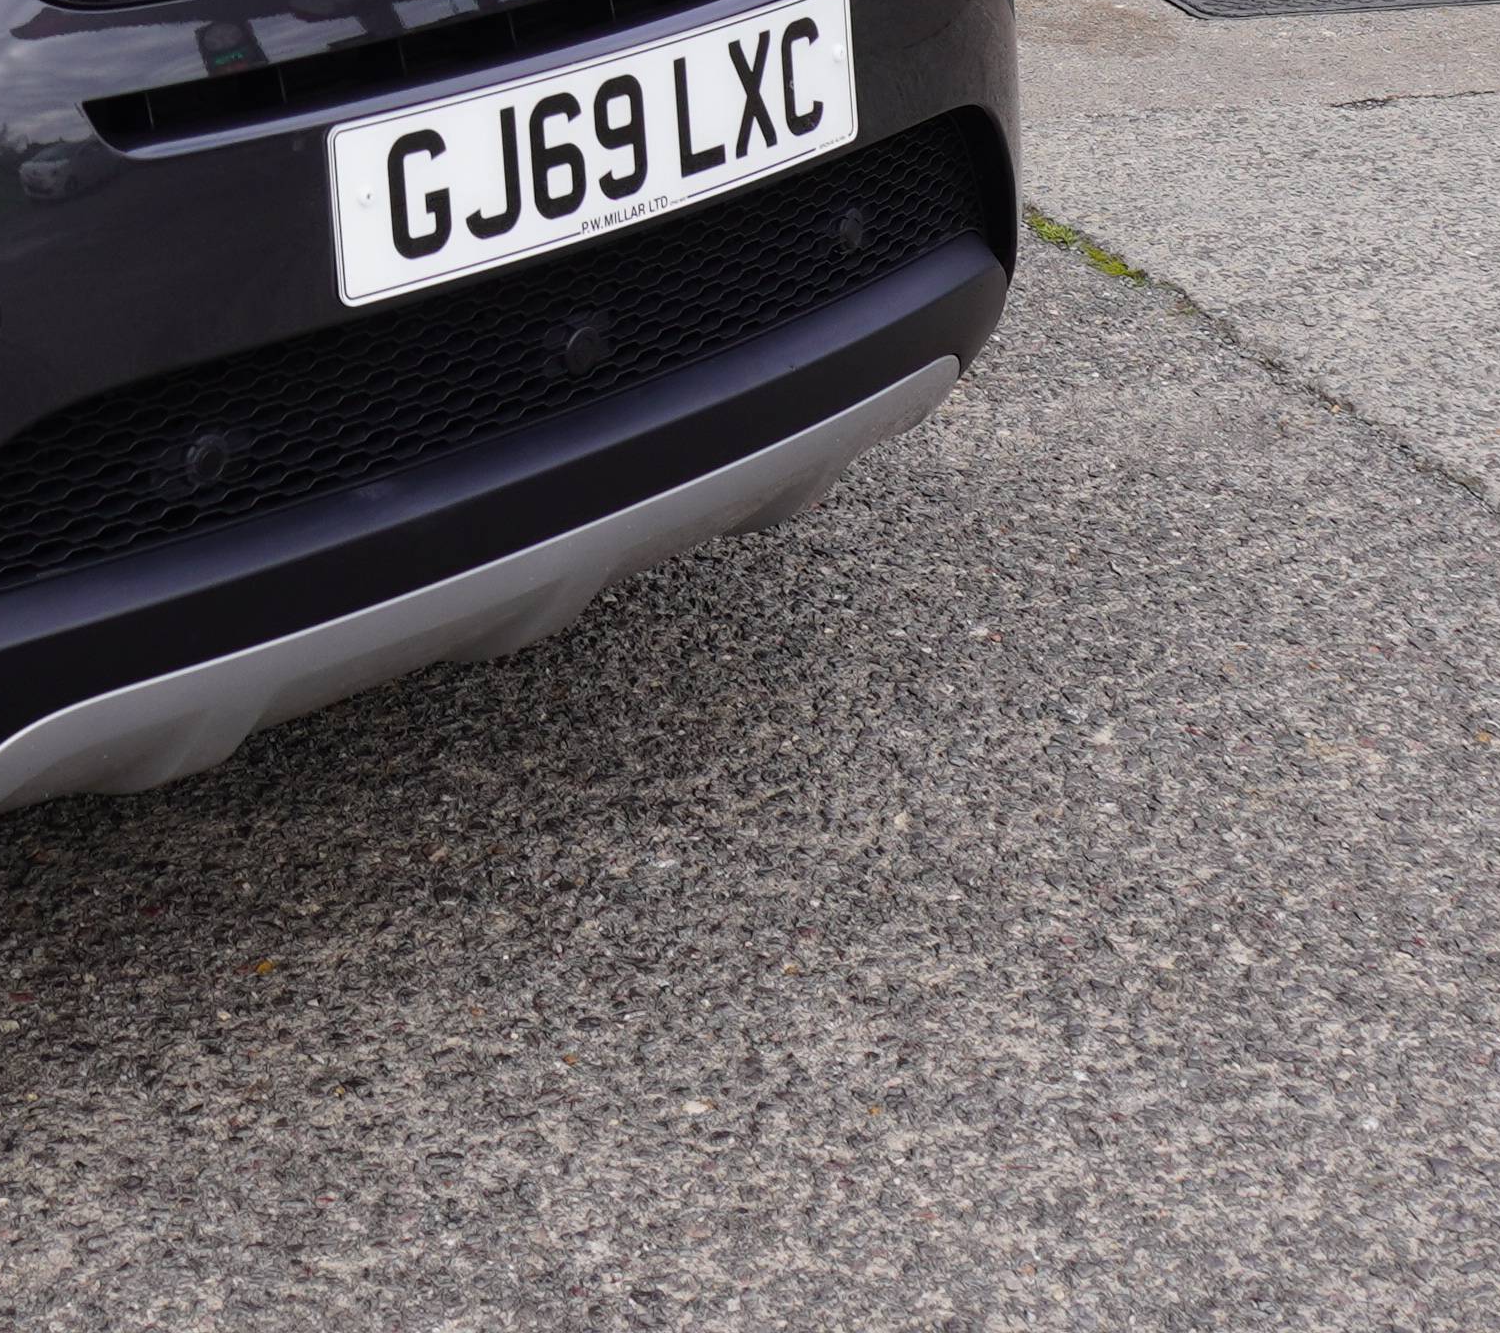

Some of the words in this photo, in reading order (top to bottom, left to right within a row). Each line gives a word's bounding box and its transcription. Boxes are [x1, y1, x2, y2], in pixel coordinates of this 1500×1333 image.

[387, 73, 649, 261] GJ69
[673, 16, 825, 179] LXC
[649, 195, 668, 213] LTD
